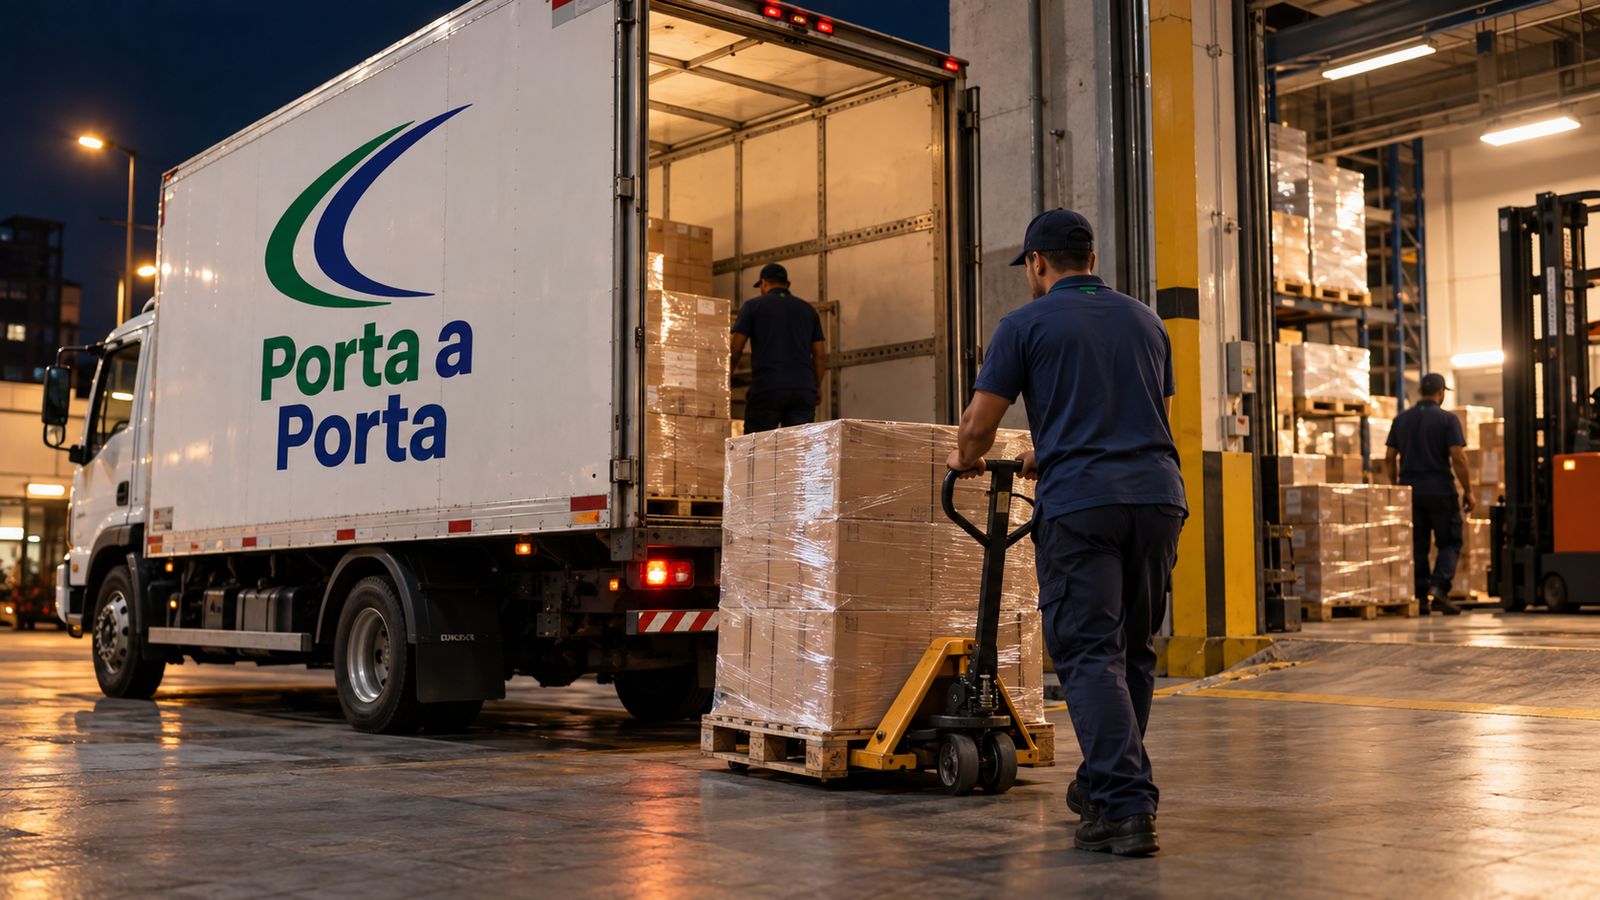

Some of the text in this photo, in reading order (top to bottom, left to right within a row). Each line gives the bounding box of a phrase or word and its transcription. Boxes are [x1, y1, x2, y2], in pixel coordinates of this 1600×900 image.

[261, 320, 473, 401] Porta a
[277, 394, 447, 470] Porta
